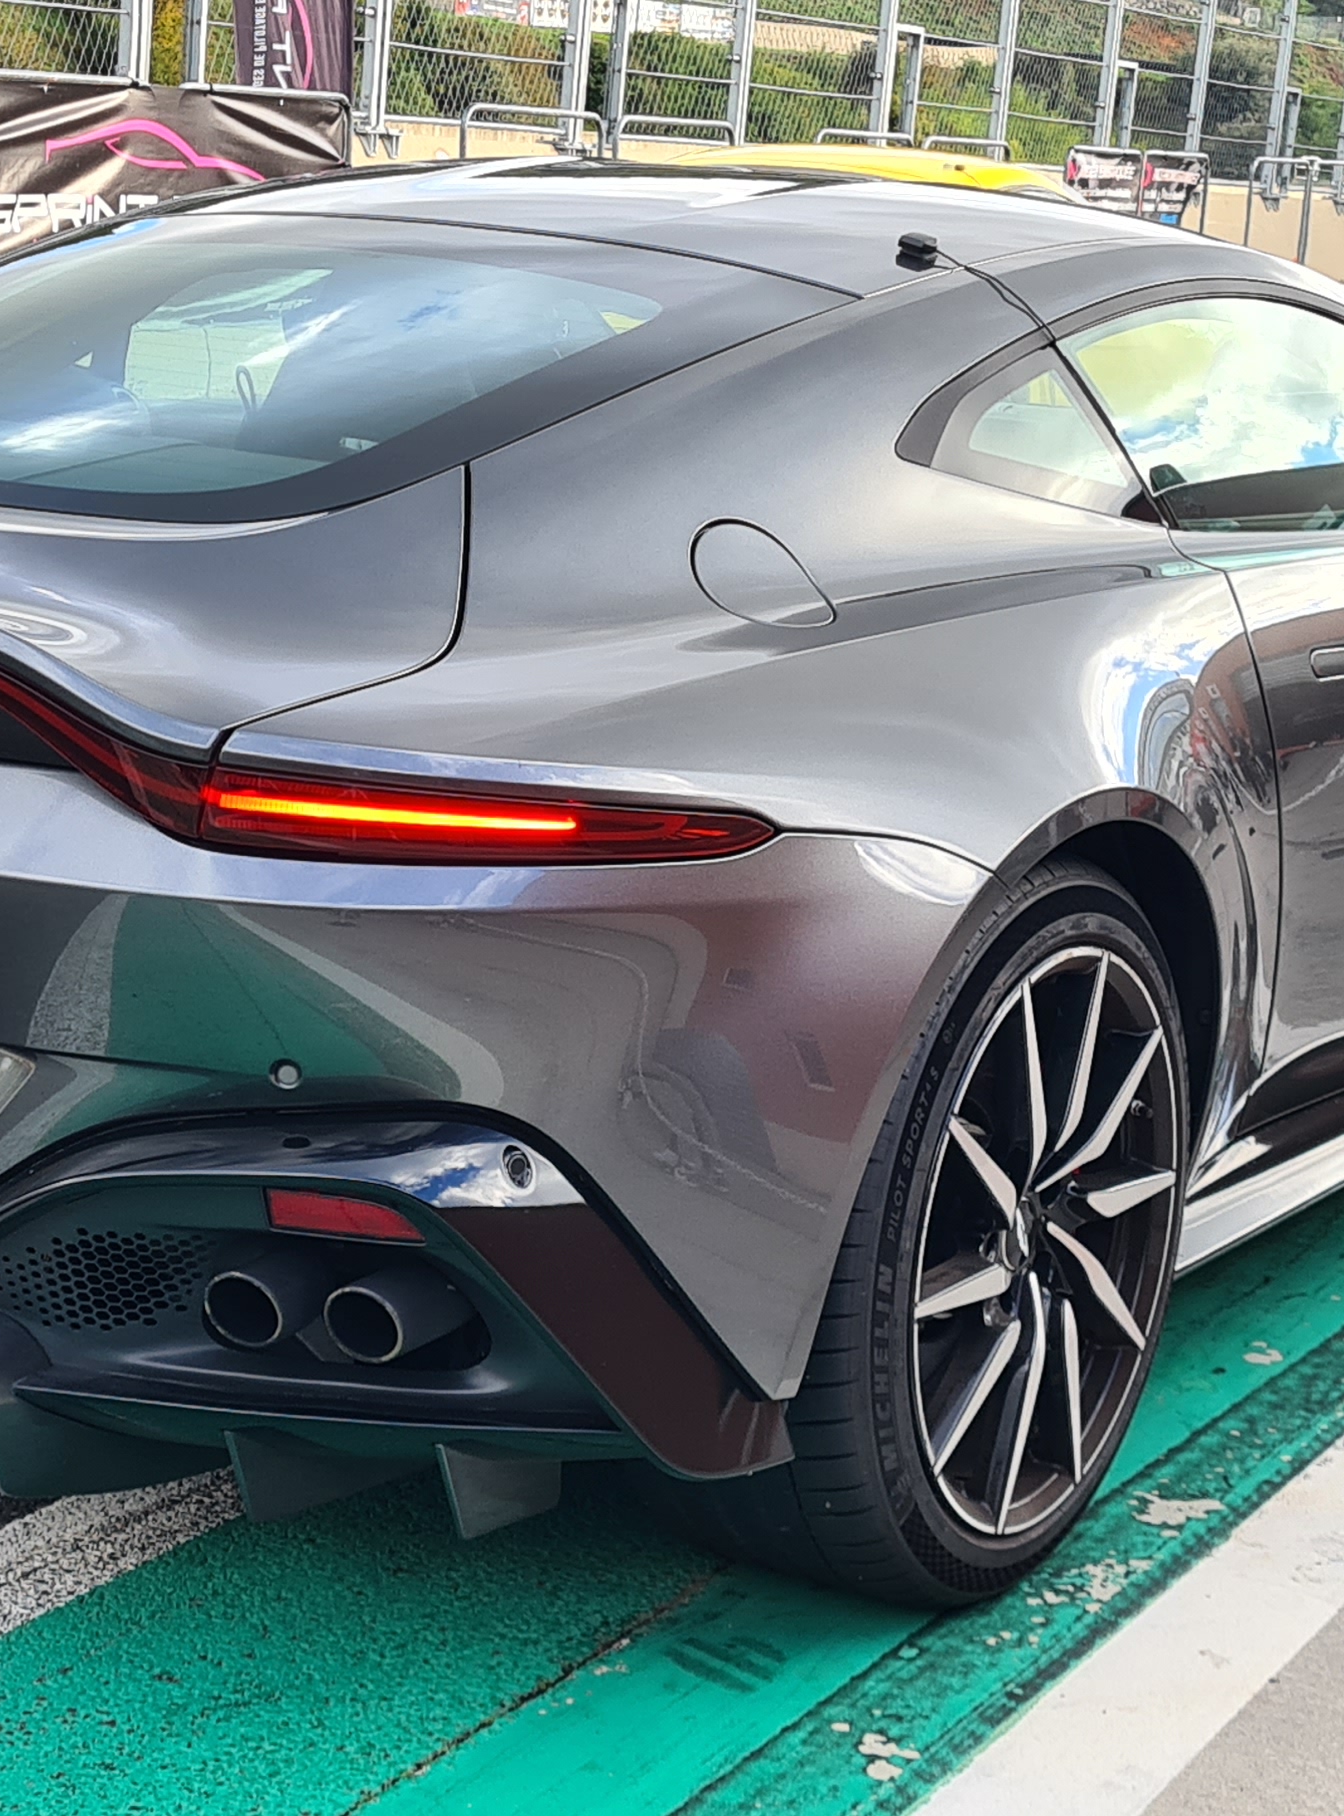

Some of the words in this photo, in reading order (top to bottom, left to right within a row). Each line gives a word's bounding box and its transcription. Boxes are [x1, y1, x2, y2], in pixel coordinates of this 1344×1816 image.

[886, 1174, 907, 1243] PILOT
[902, 1095, 927, 1168] SPORT
[873, 1263, 899, 1472] MICHELIN
